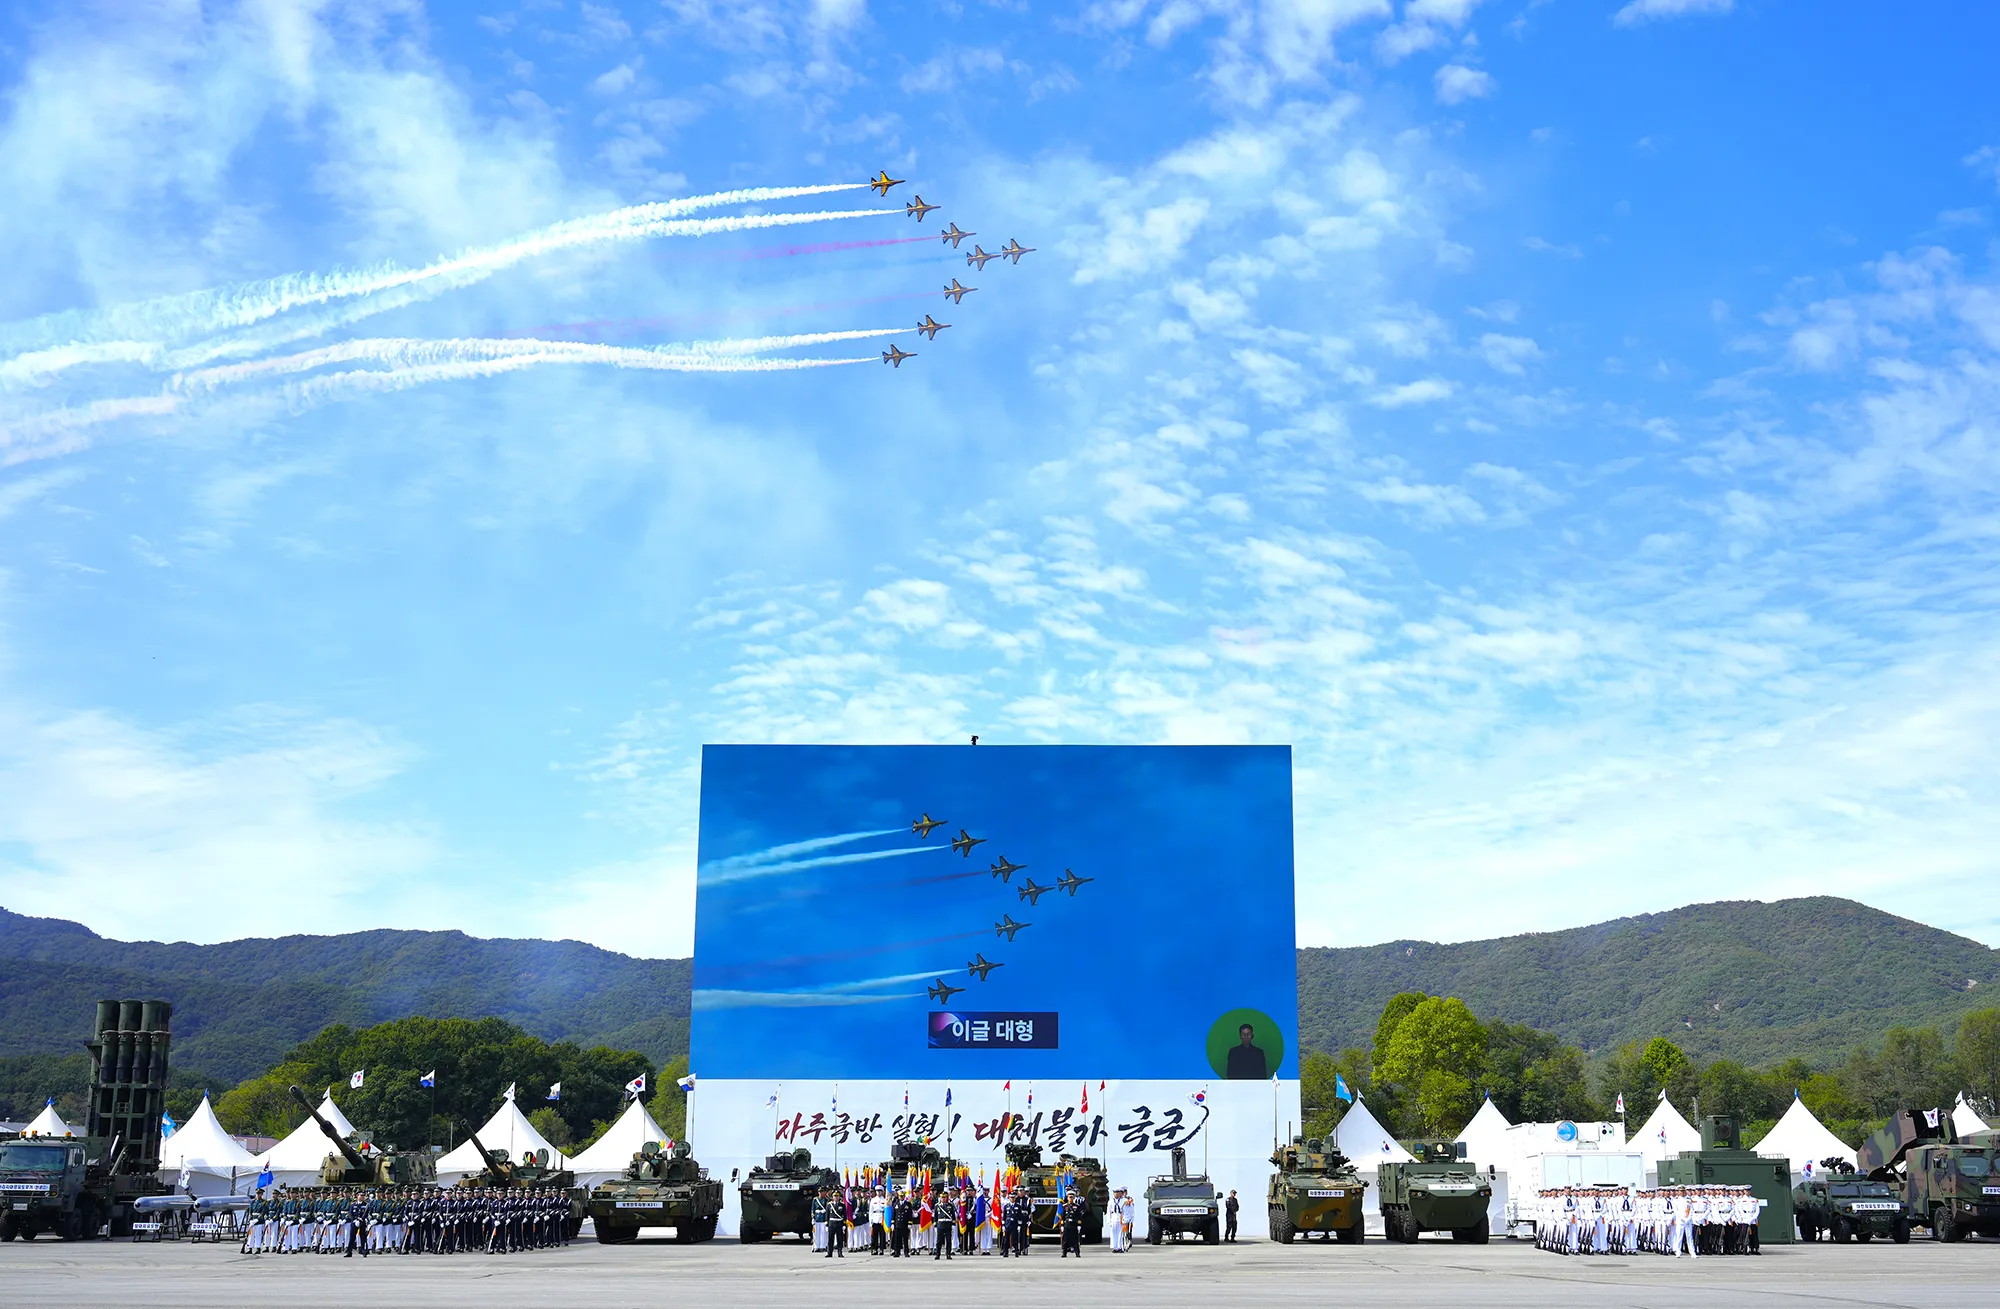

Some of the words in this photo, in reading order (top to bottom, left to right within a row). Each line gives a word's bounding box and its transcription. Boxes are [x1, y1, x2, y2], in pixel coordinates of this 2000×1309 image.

[952, 1019, 991, 1042] 이글
[995, 1019, 1034, 1042] 대형
[775, 1111, 883, 1146] 자주국방
[1118, 1105, 1210, 1153] 국군
